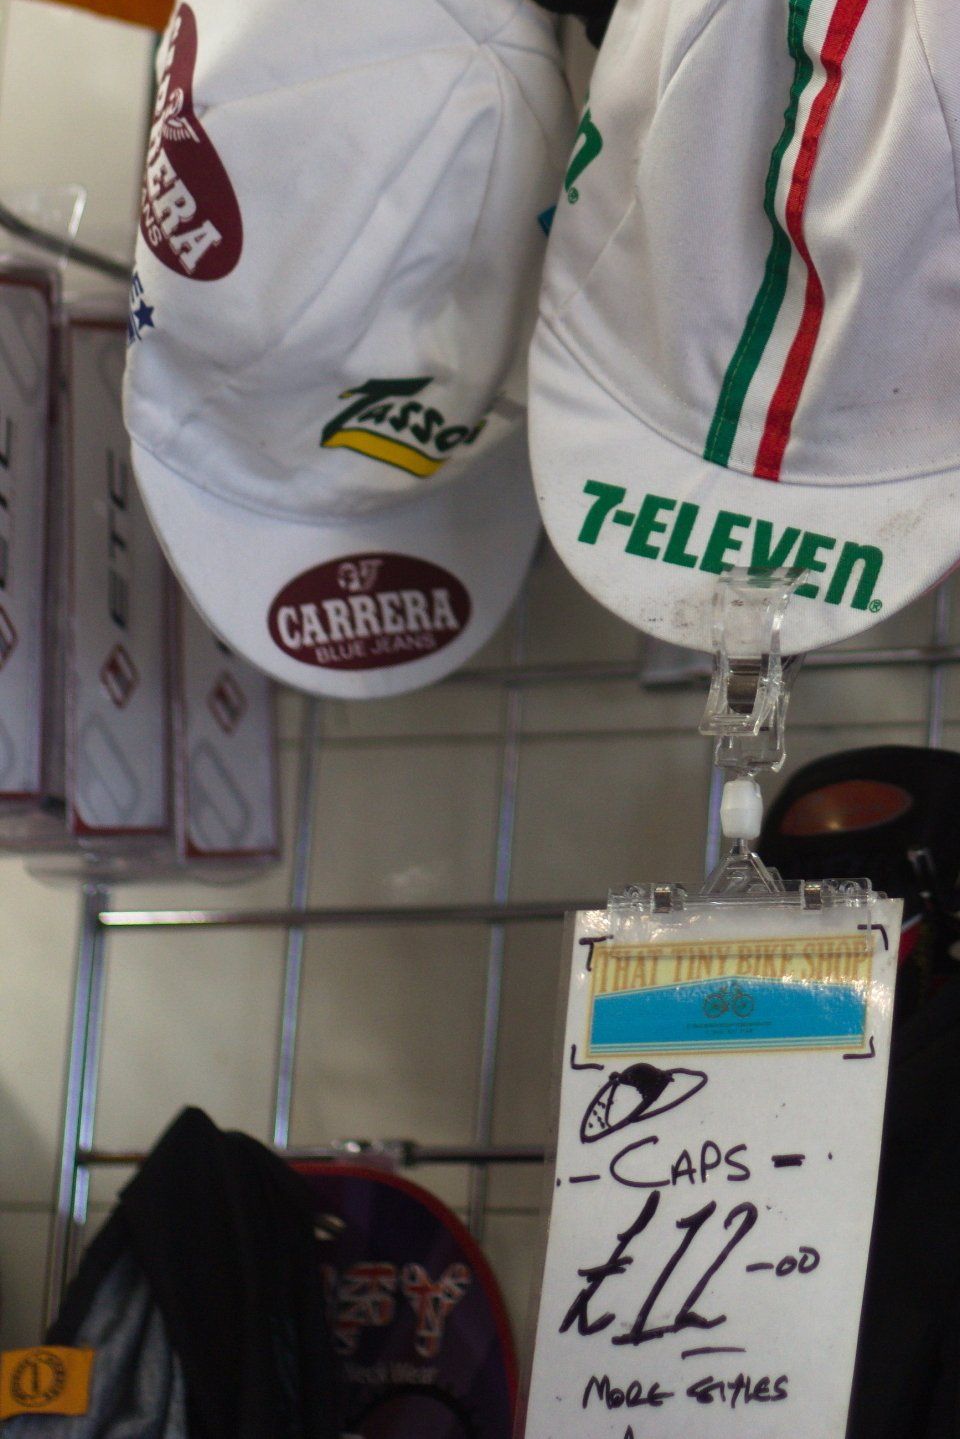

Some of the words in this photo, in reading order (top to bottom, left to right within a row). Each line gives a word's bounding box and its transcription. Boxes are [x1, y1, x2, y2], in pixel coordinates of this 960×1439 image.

[276, 588, 459, 650] CARRERA
[315, 642, 367, 664] BLUE
[370, 632, 437, 658] JEANS
[597, 946, 664, 993] THAT
[670, 943, 732, 983] TINY
[736, 939, 795, 979] BIKE
[800, 938, 869, 984] SHOP
[608, 1135, 751, 1189] CAPS
[582, 1374, 674, 1409] MORE
